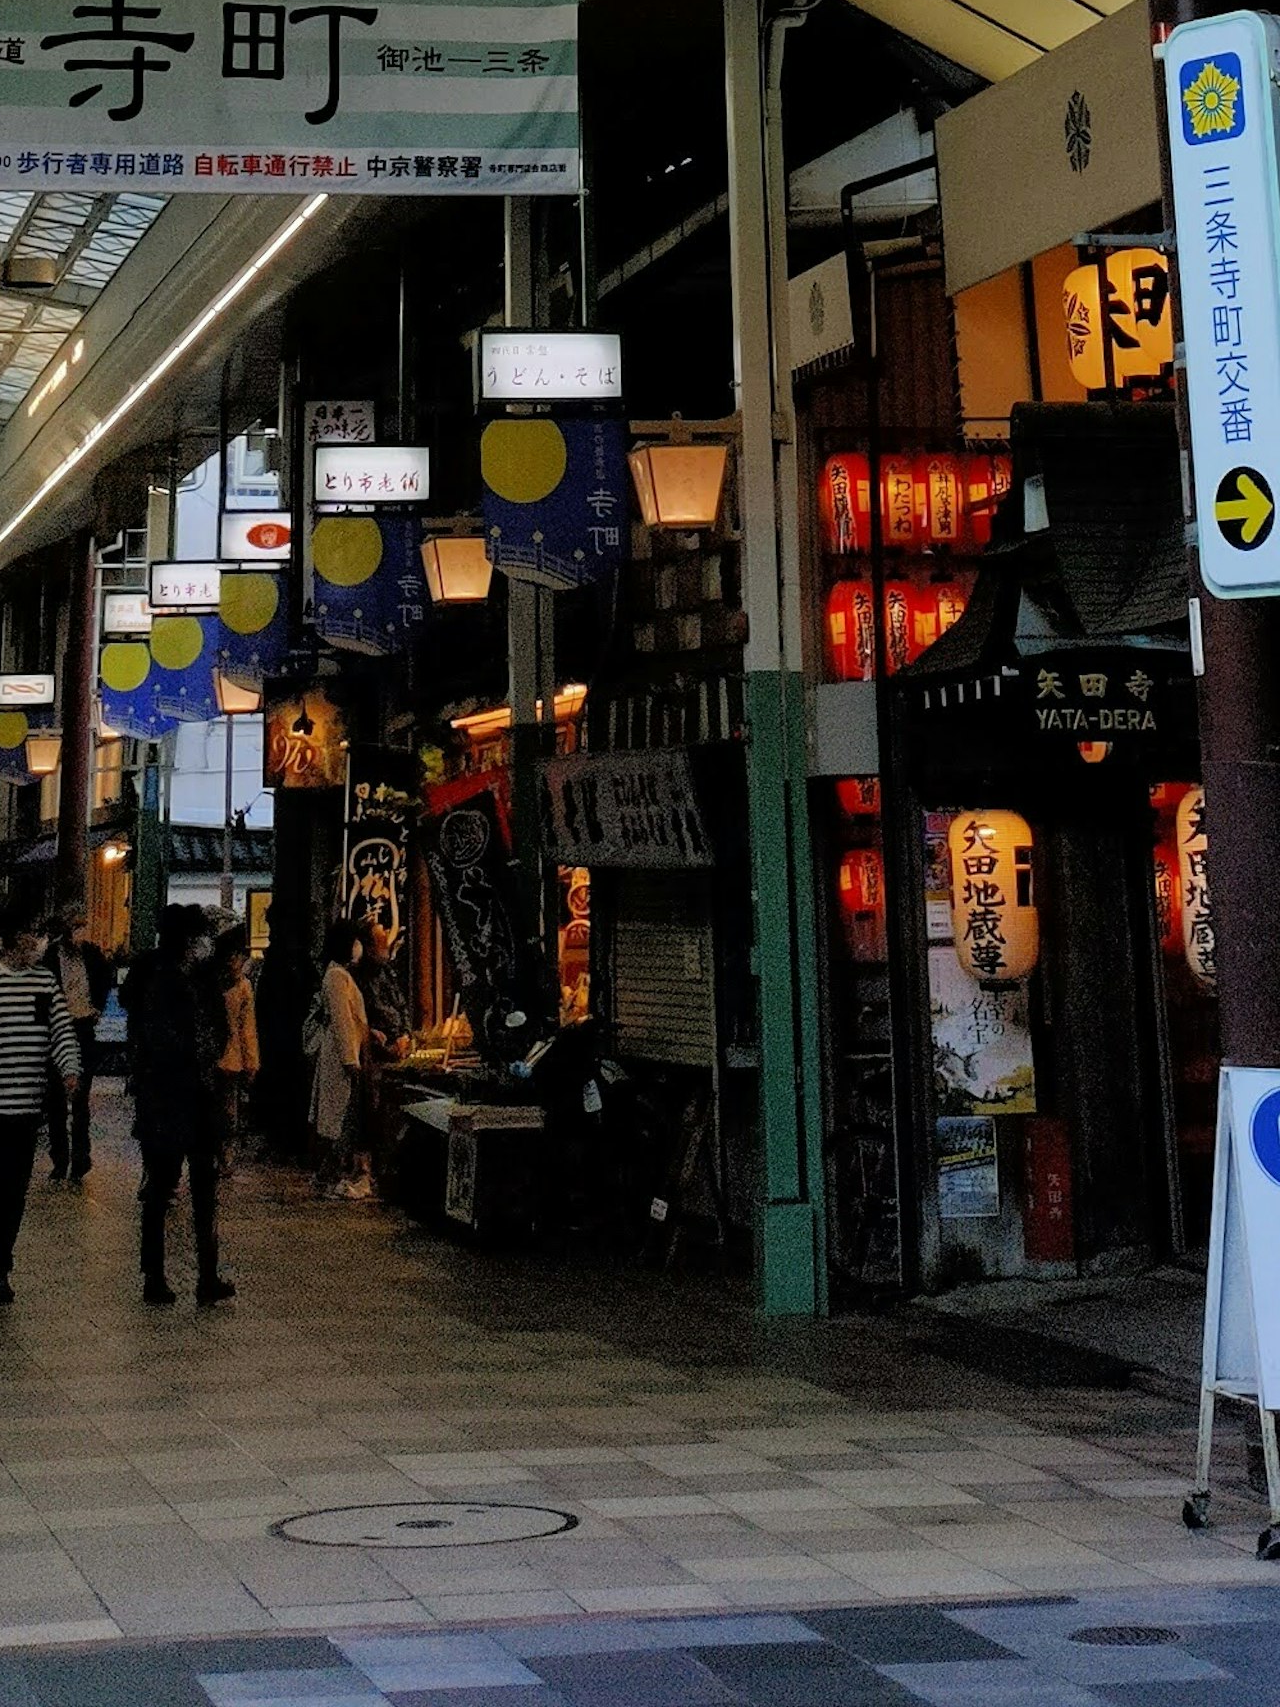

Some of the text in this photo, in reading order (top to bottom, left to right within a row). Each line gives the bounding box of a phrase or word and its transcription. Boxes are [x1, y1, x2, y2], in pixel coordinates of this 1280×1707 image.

[17, 152, 184, 176] 歩行者専用道路
[194, 154, 357, 177] 自転車通行禁止
[367, 155, 482, 178] 中京警察署
[1203, 165, 1252, 444] 三条寺町交番
[487, 366, 616, 386] うどん・そば
[1036, 668, 1154, 702] 矢田寺
[1035, 709, 1157, 730] YATA-DERA
[962, 820, 1007, 975] 矢田地蔵尊
